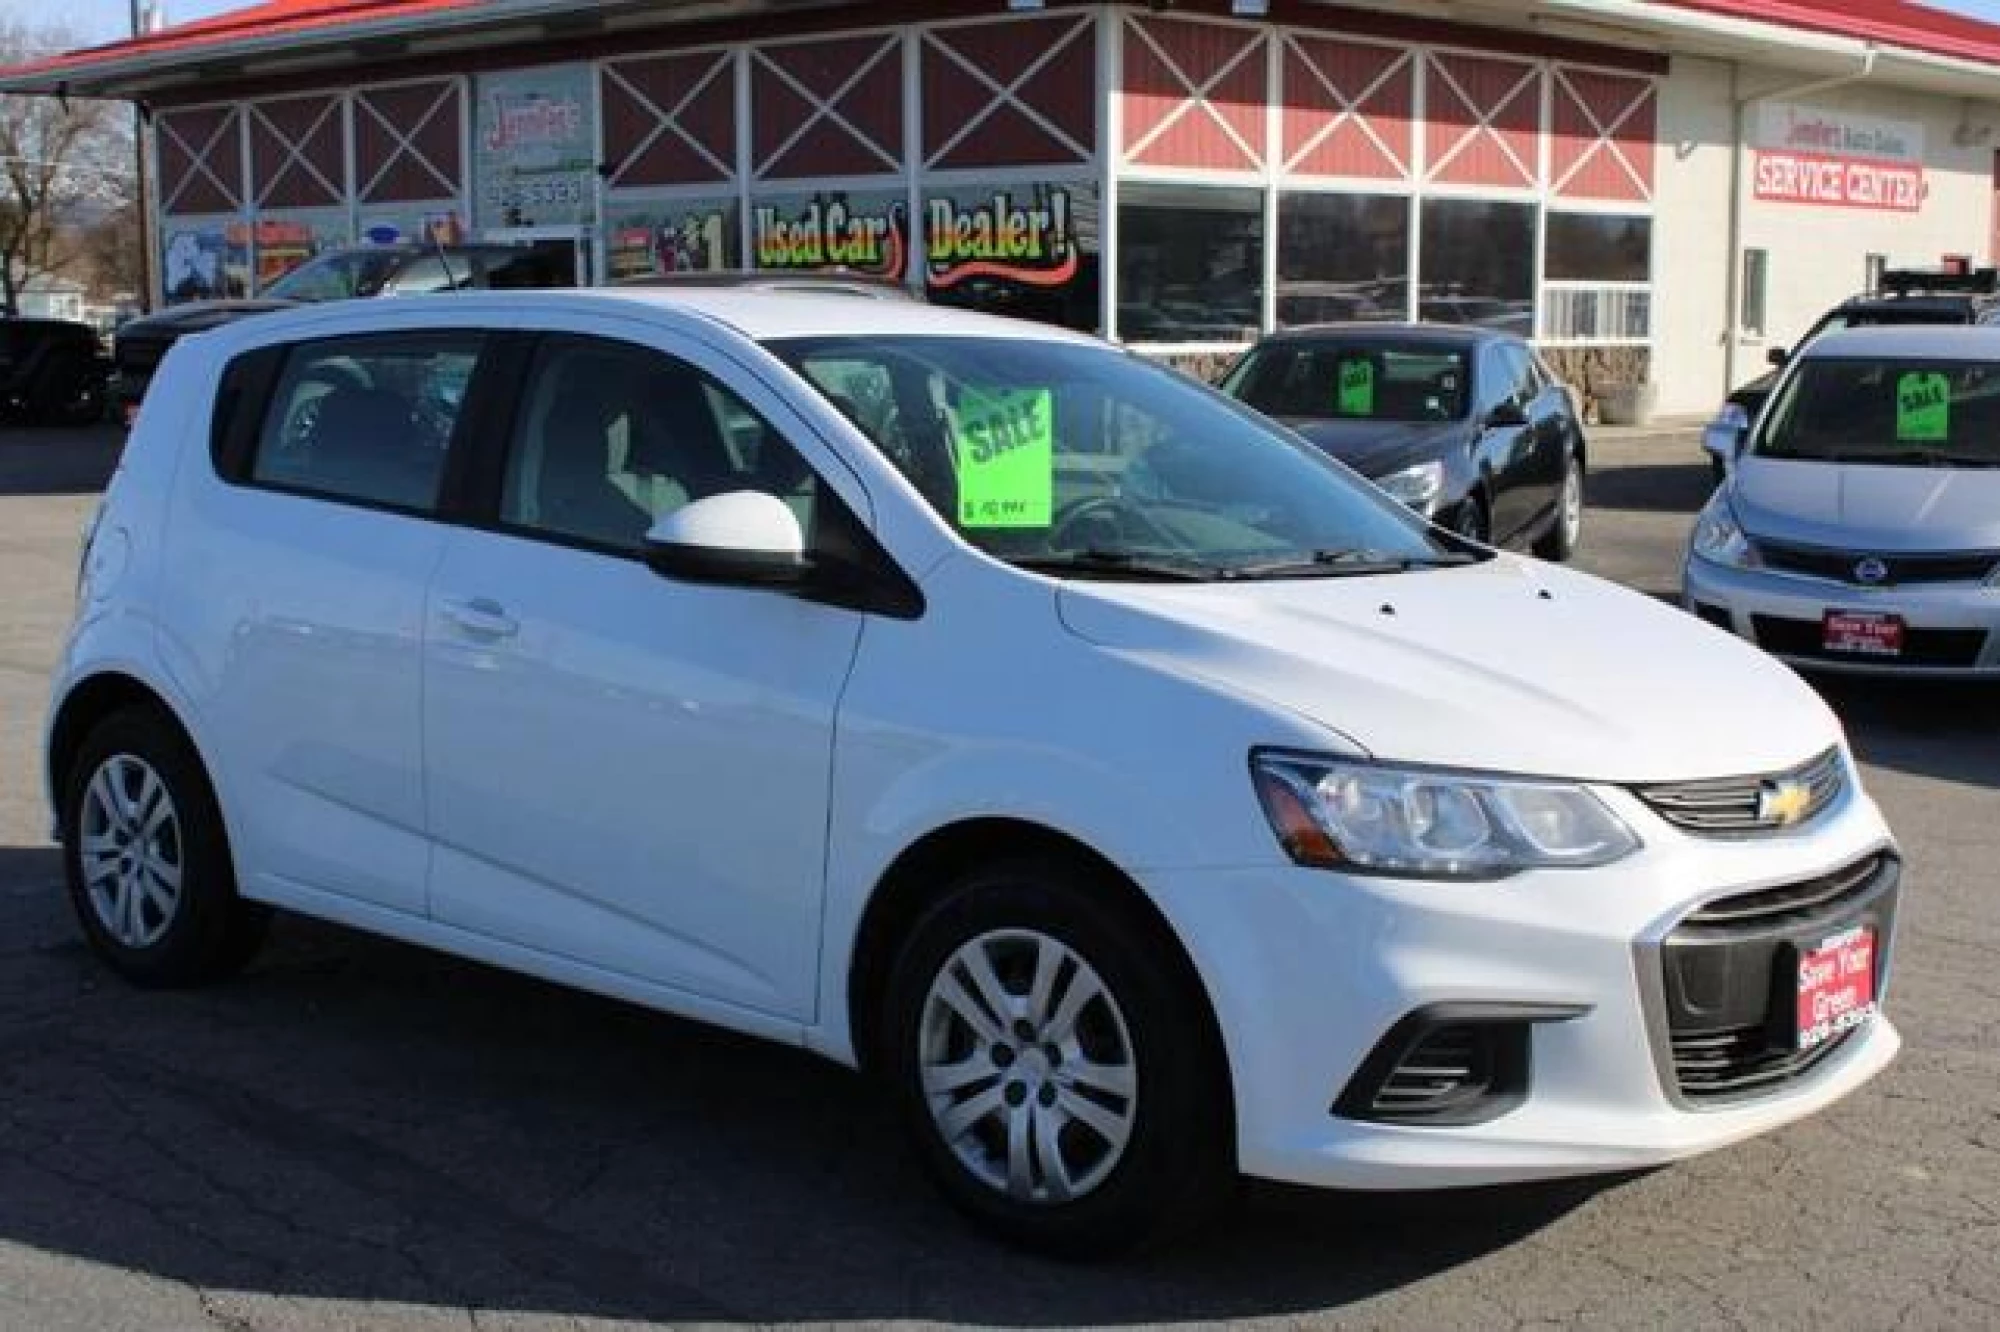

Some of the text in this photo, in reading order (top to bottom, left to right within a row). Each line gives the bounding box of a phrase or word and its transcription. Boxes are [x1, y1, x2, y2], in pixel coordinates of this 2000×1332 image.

[1757, 155, 1919, 208] SERVICE CENTER
[755, 203, 823, 265] Used
[928, 193, 1067, 260] Dealer!
[963, 398, 1046, 463] SALE
